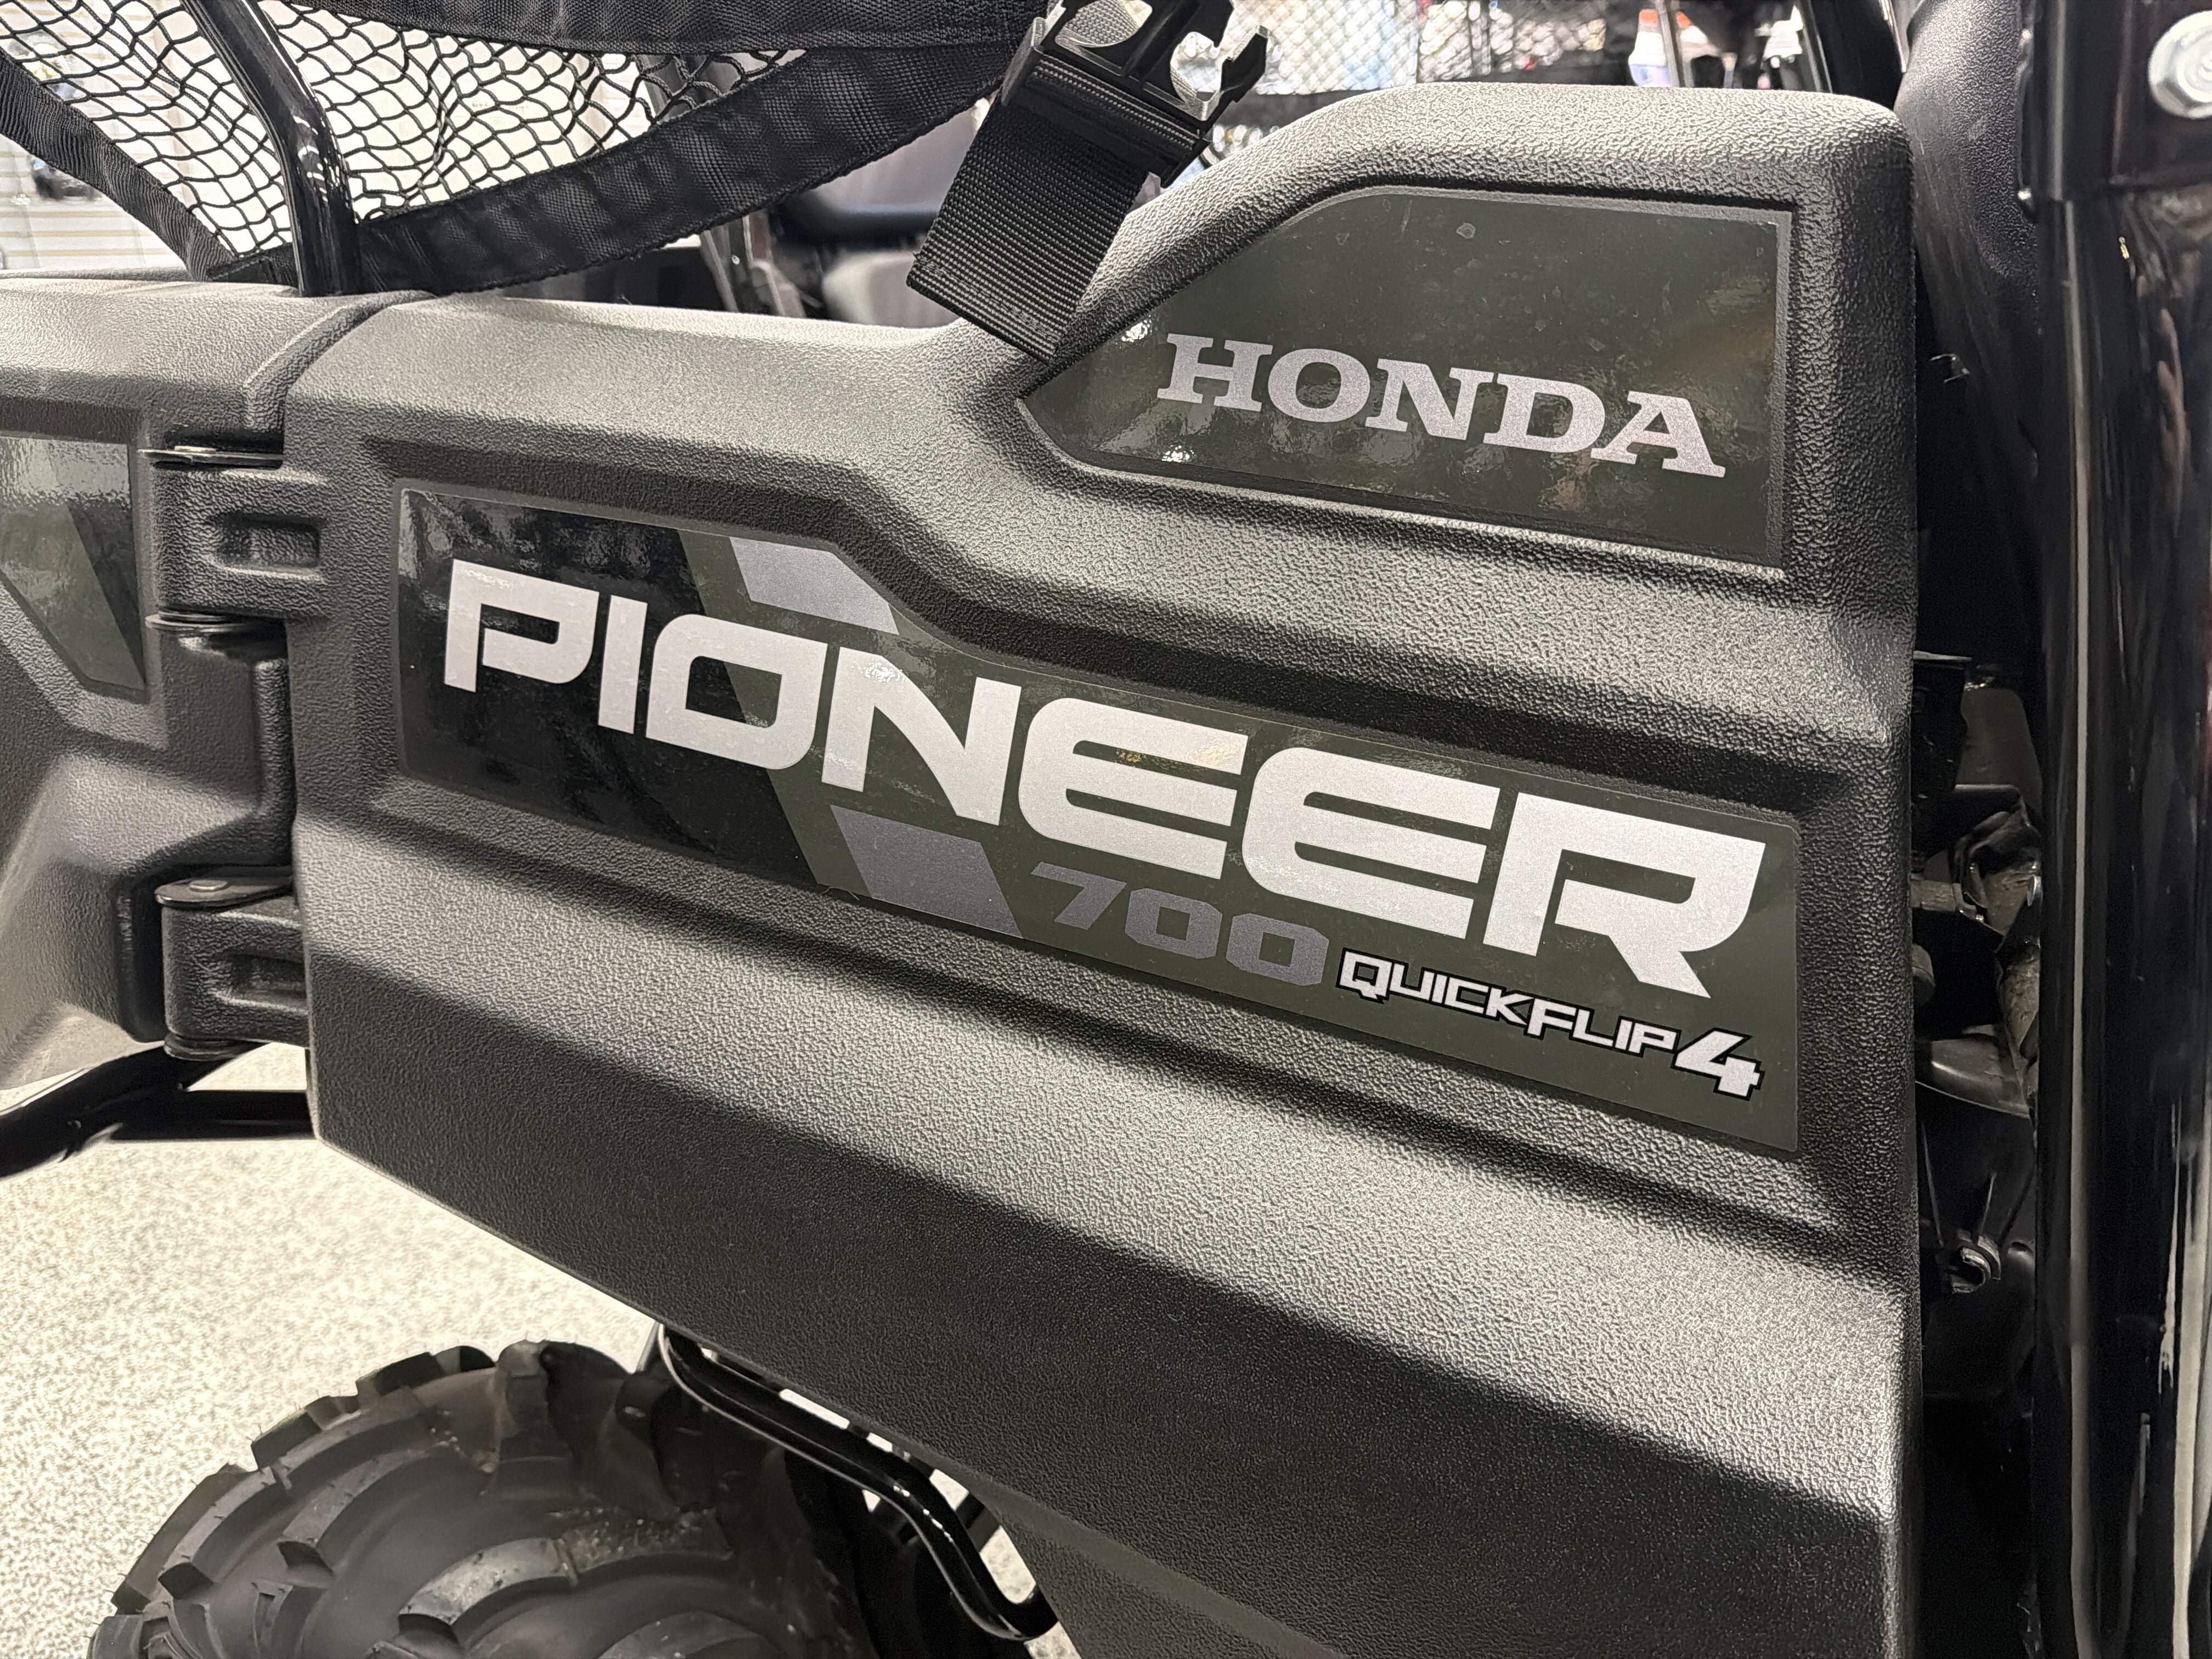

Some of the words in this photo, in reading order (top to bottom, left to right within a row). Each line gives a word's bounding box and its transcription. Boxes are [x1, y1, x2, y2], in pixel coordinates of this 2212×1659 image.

[1156, 333, 1726, 478] HONDA
[444, 558, 1767, 999] PIONEER
[1030, 861, 1330, 986] 700
